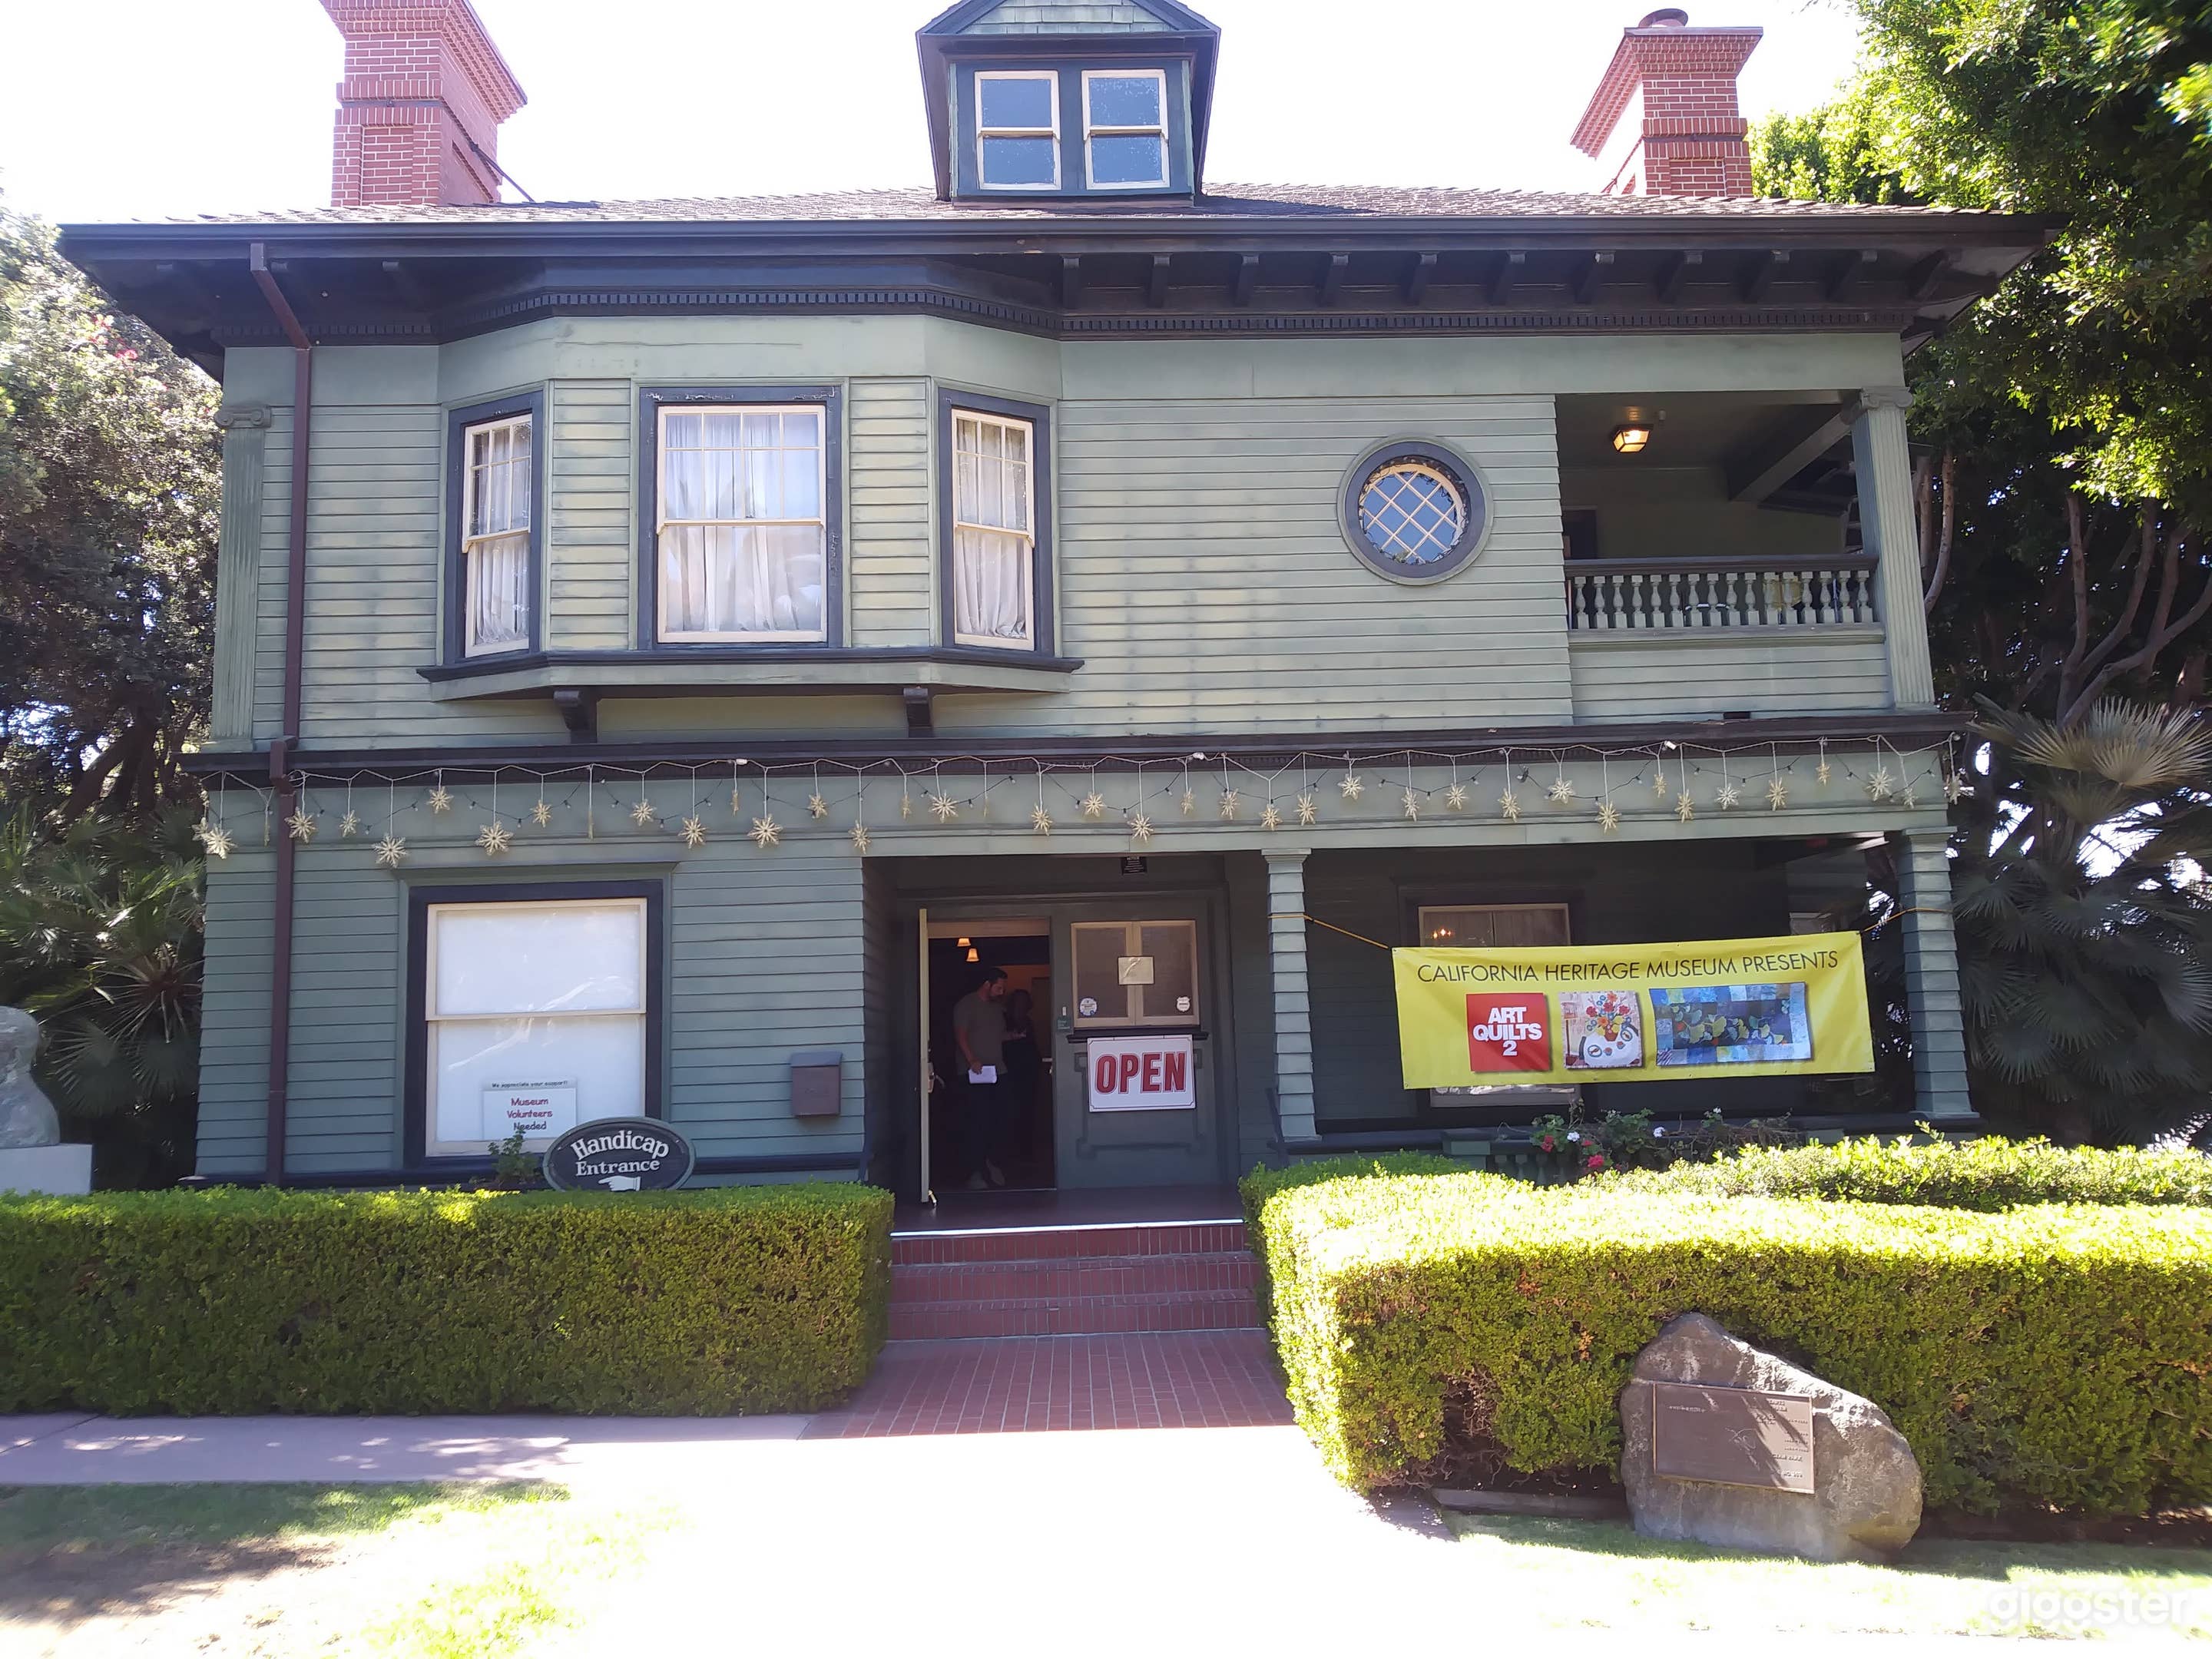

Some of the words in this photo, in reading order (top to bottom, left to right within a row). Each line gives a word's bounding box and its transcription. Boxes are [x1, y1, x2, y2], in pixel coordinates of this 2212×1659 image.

[1417, 964, 1538, 982] CALIFORNIA
[1545, 962, 1640, 982] HERITAGE
[1647, 958, 1737, 979] MUSEUM
[1743, 950, 1838, 973] PRESENTS
[1488, 1007, 1527, 1024] ART
[1473, 1023, 1542, 1041] QUILTS
[1502, 1040, 1518, 1056] 2
[1094, 1051, 1187, 1094] OPEN
[511, 1098, 548, 1106] Museum
[507, 1110, 553, 1118] Volunteers
[513, 1121, 547, 1131] Needed
[571, 1130, 669, 1161] Handicap
[575, 1160, 660, 1177] Entrance
